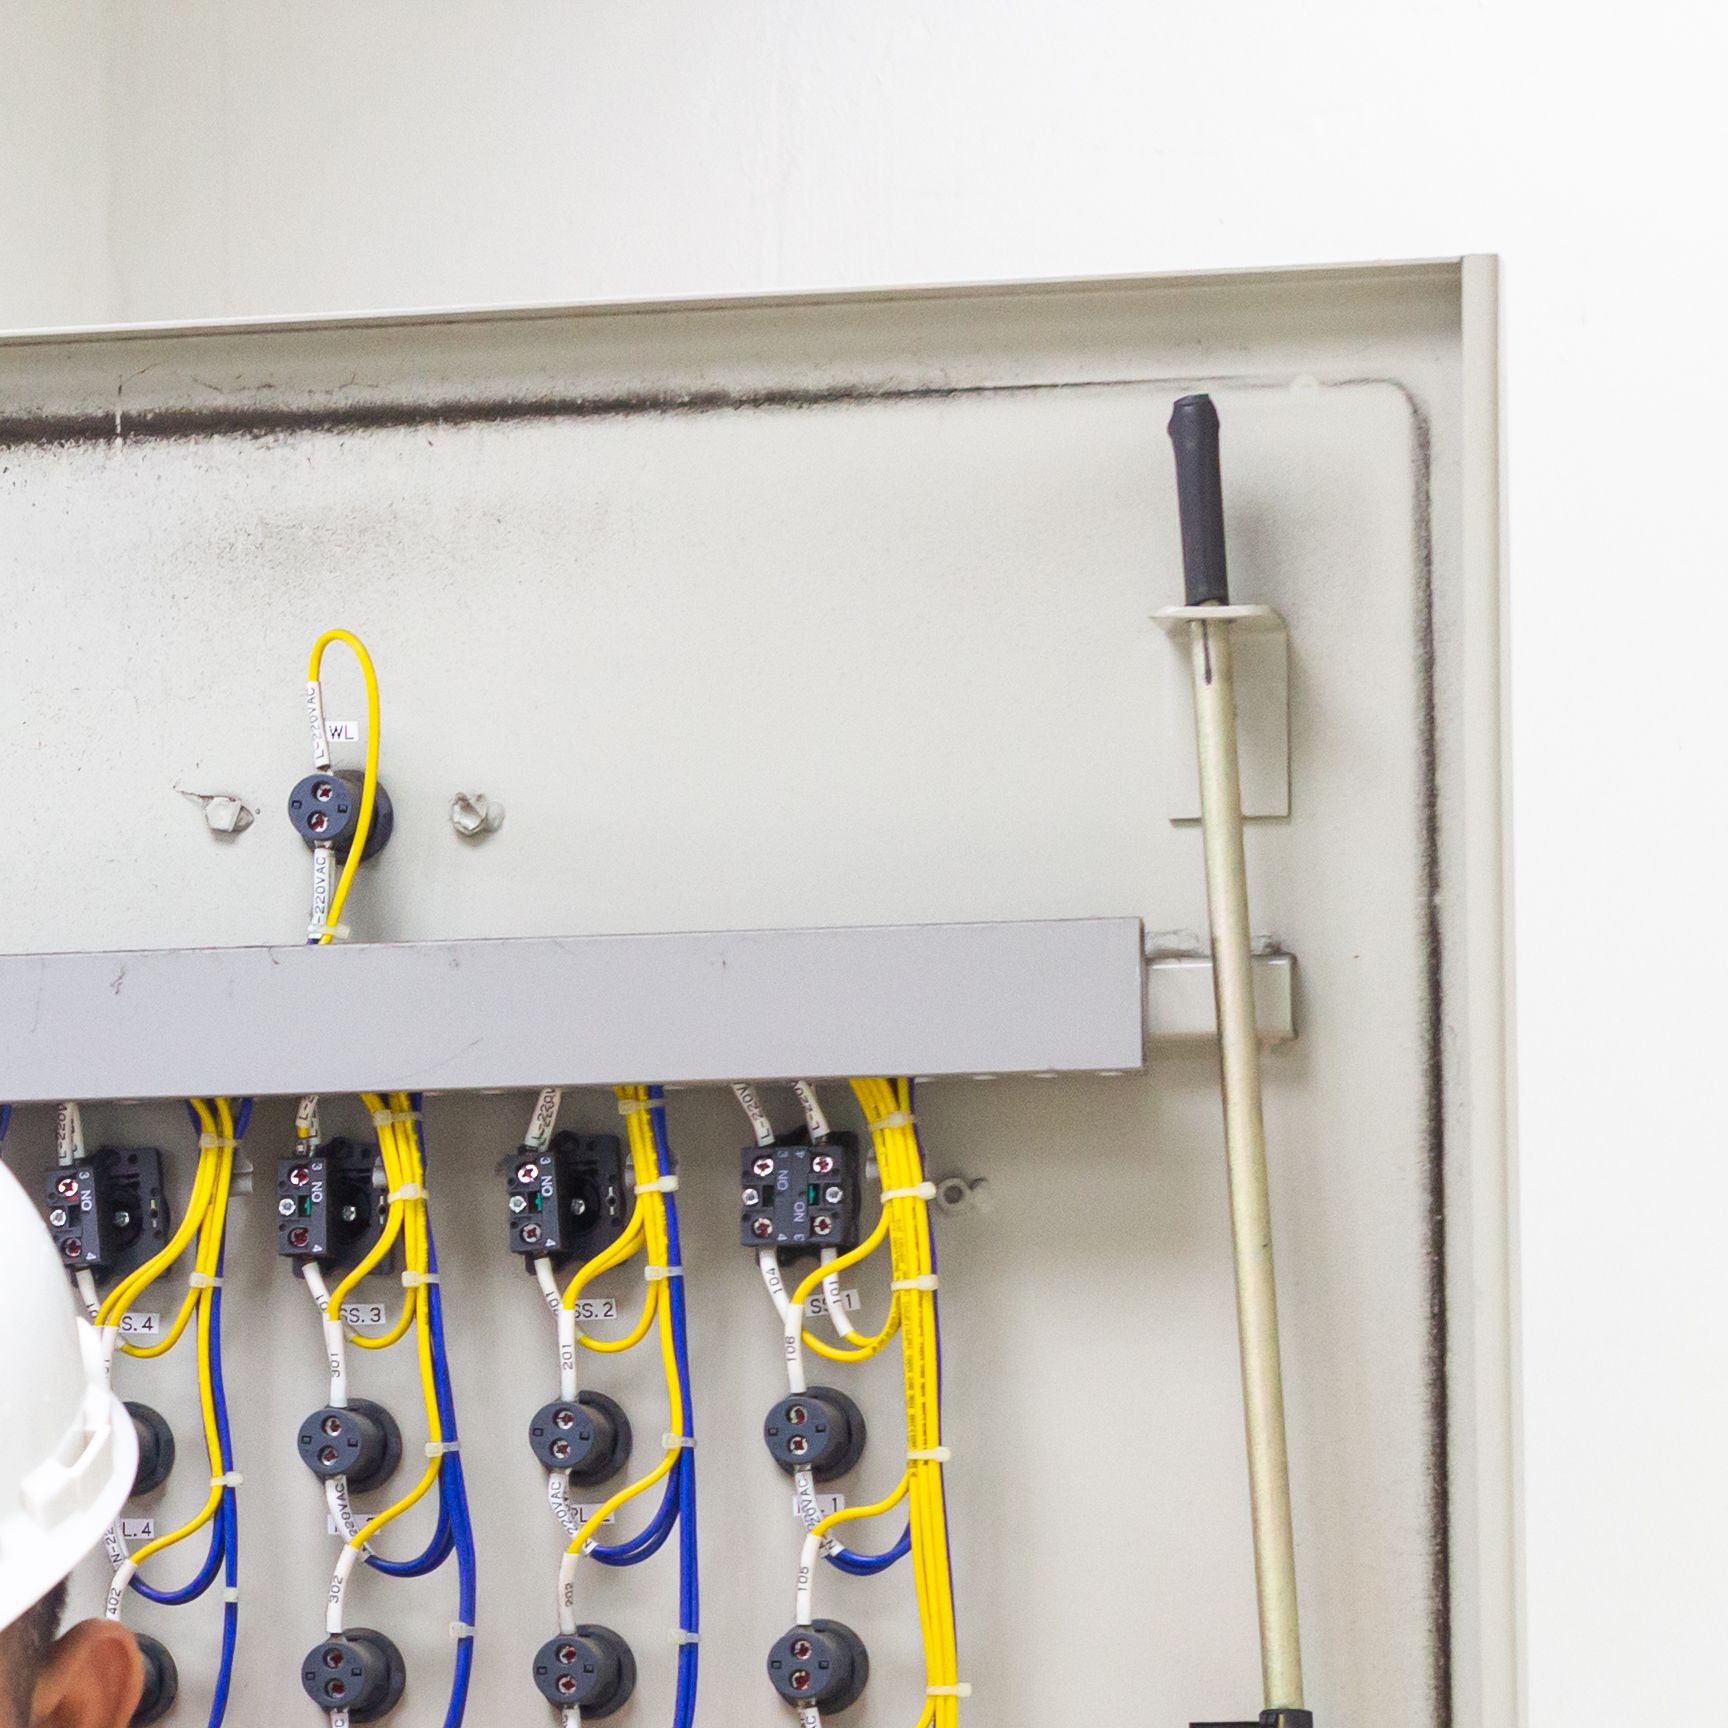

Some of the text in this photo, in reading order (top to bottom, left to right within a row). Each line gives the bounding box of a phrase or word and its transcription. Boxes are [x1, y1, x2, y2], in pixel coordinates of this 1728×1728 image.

[306, 687, 326, 760] L-220VAC
[329, 725, 354, 740] WL
[314, 855, 327, 924] -220VAC
[776, 1168, 790, 1191] NO
[80, 1189, 93, 1212] NO
[311, 1162, 324, 1253] 3 NO 4
[540, 1156, 556, 1247] 3 NO 4
[793, 1201, 806, 1223] NO
[85, 1251, 97, 1260] 4
[315, 1294, 329, 1313] 01
[121, 1316, 153, 1331] S.4
[330, 1353, 341, 1378] 301
[561, 1343, 573, 1371] 201
[122, 1521, 152, 1538] L.4
[108, 1586, 123, 1617] 402
[329, 1576, 343, 1604] 302
